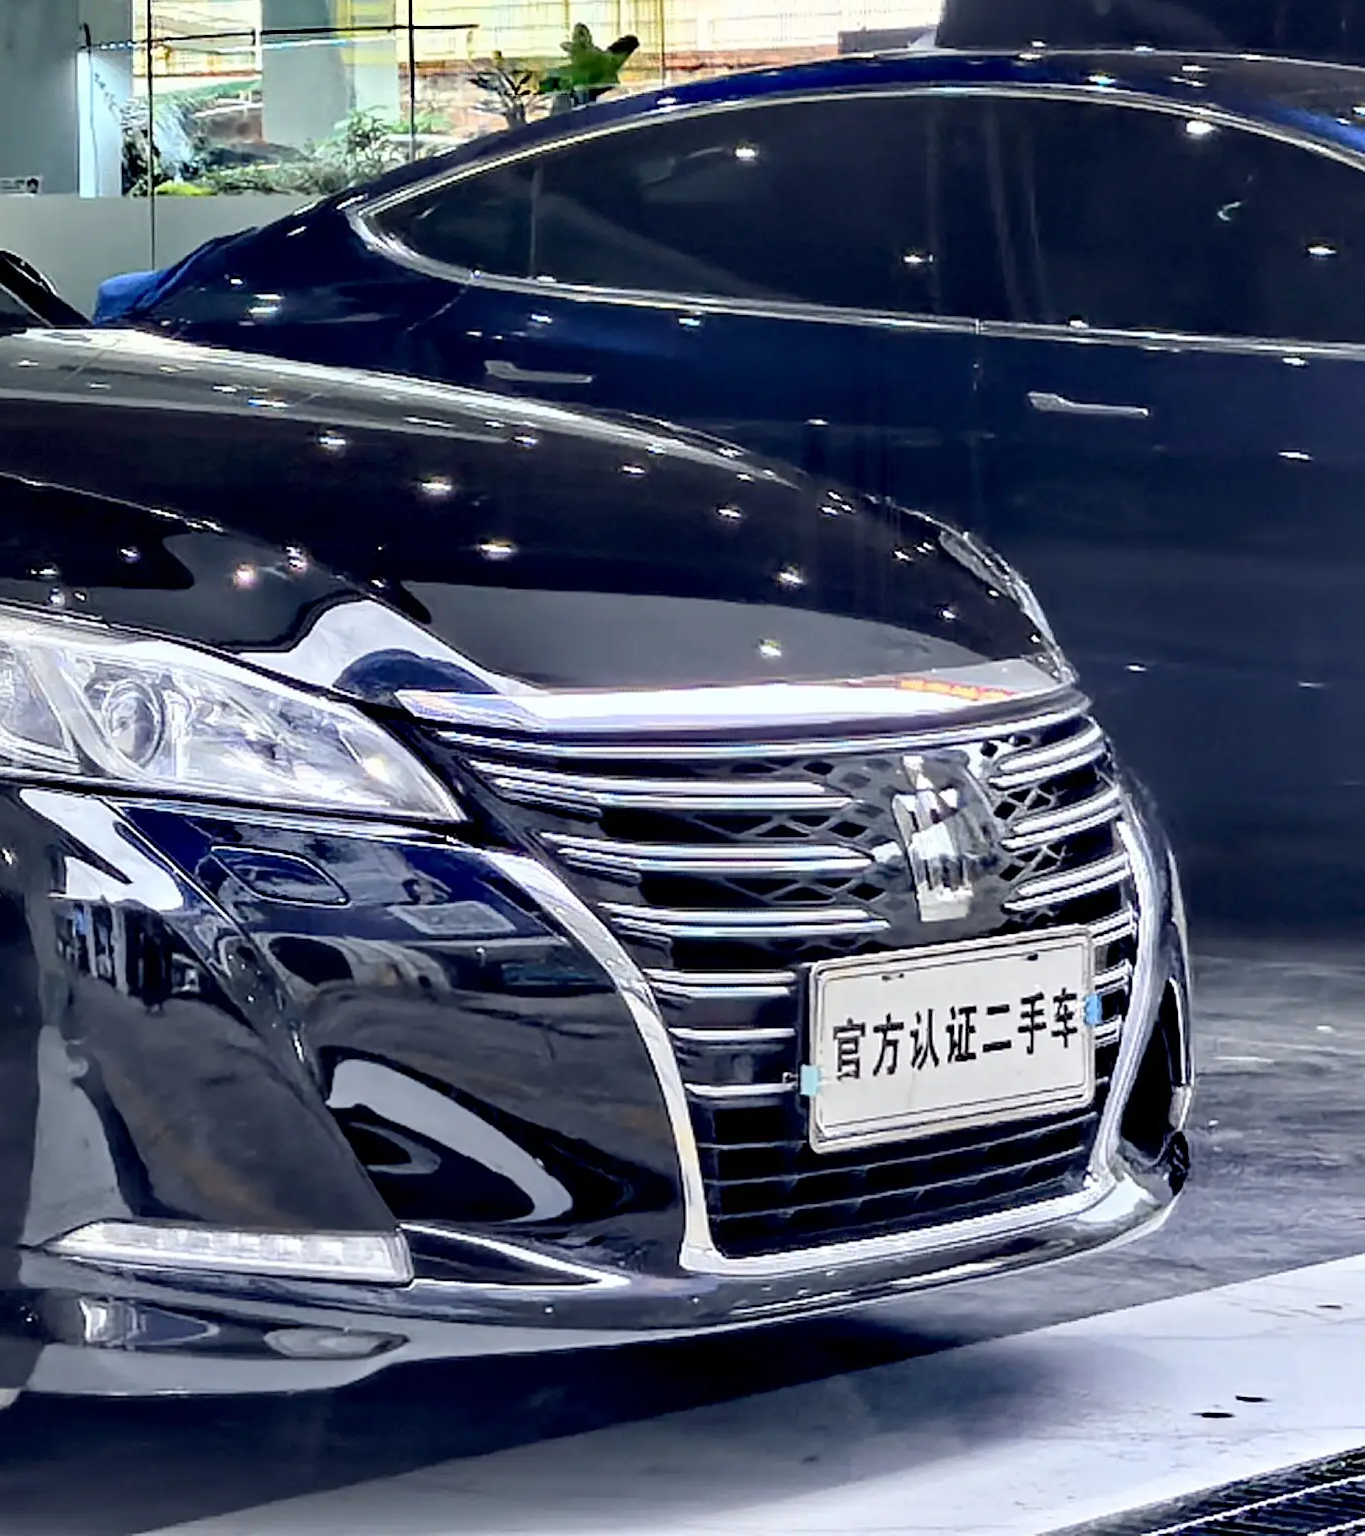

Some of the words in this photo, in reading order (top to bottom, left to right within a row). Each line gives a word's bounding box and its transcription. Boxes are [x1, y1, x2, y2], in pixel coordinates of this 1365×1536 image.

[832, 987, 1078, 1081] 官方认证二手车
